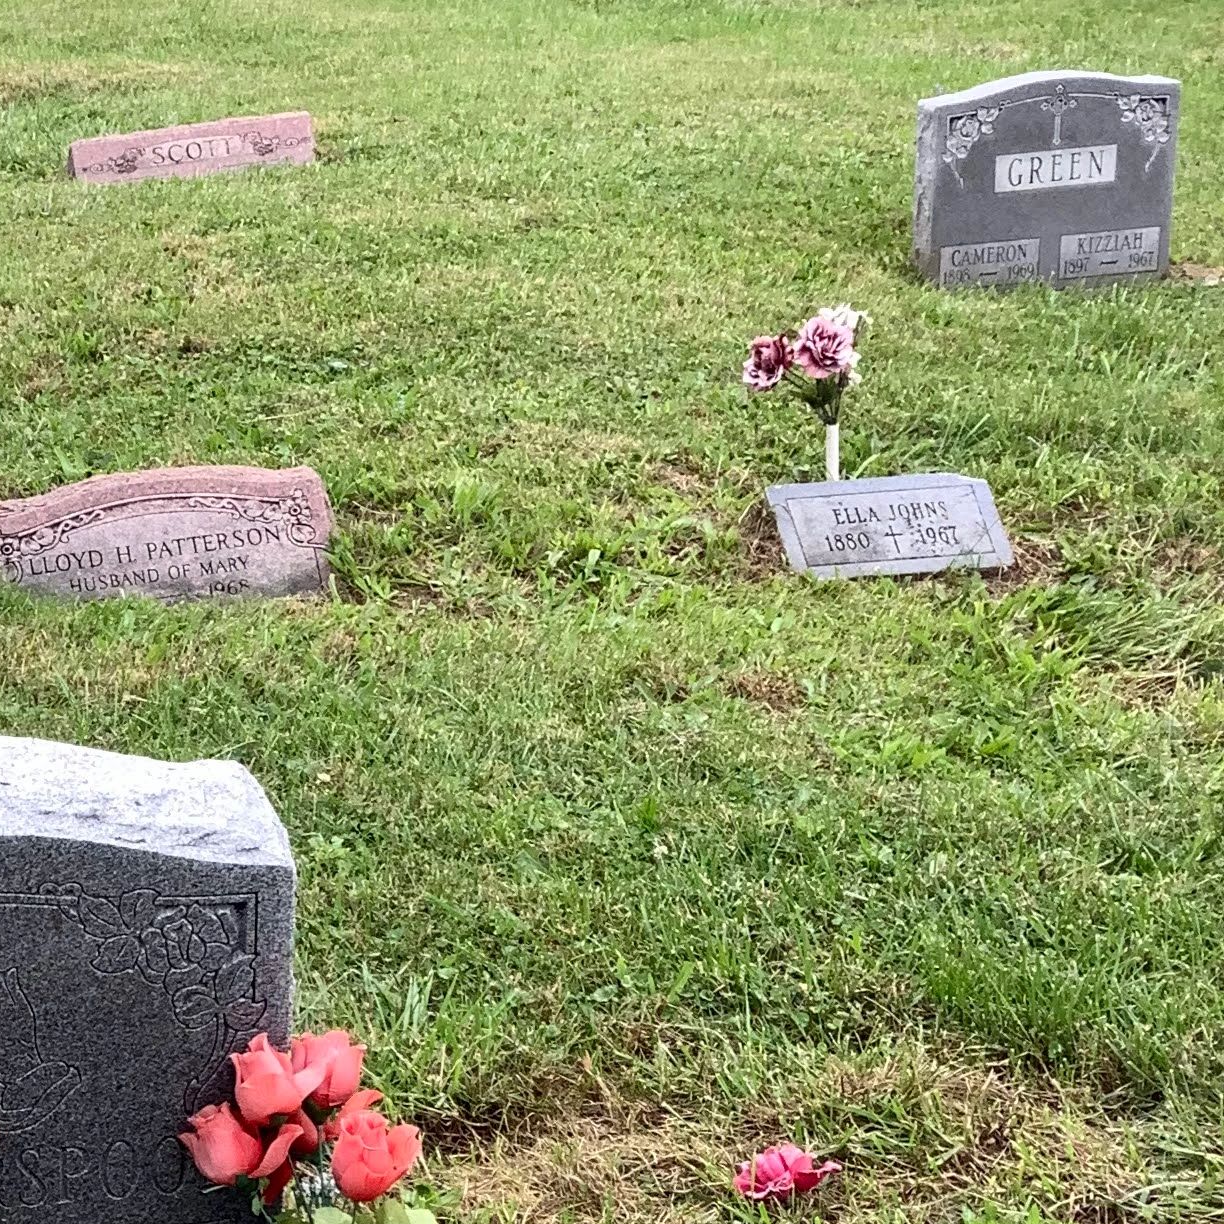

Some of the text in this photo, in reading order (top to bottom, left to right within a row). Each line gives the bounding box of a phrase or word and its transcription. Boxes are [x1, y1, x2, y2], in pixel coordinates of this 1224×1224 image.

[152, 138, 234, 165] SCOTT
[1007, 149, 1106, 188] GREEN
[951, 244, 1028, 267] CAMERON
[1077, 232, 1143, 255] KIZZIAH
[1007, 262, 1035, 280] 1969
[1064, 251, 1155, 275] 1897 1967
[832, 501, 948, 526] ELLA JOHNS
[29, 550, 104, 576] LLOYD
[145, 525, 282, 560] PATTERSON
[825, 525, 961, 552] 1880 1967
[69, 554, 250, 593] HUSBAND OF MARY
